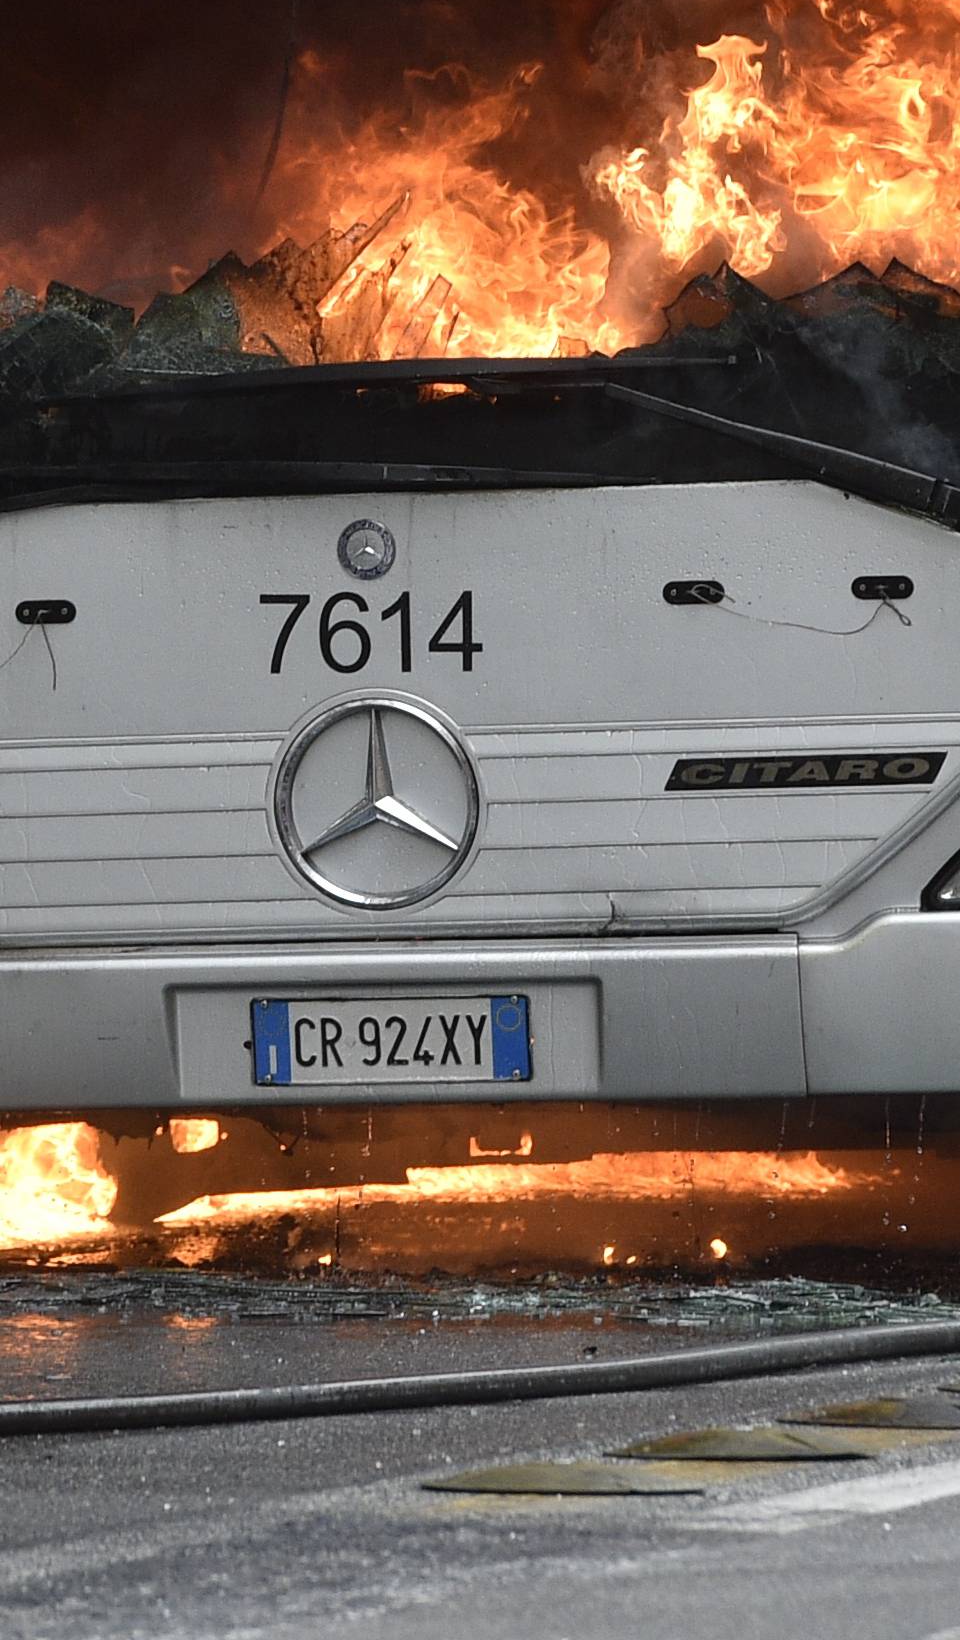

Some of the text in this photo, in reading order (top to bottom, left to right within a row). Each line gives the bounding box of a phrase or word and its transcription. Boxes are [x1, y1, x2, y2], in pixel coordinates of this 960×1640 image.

[259, 590, 483, 674] 7614
[680, 757, 931, 785] CITARO
[294, 1014, 488, 1067] CR 924XY
